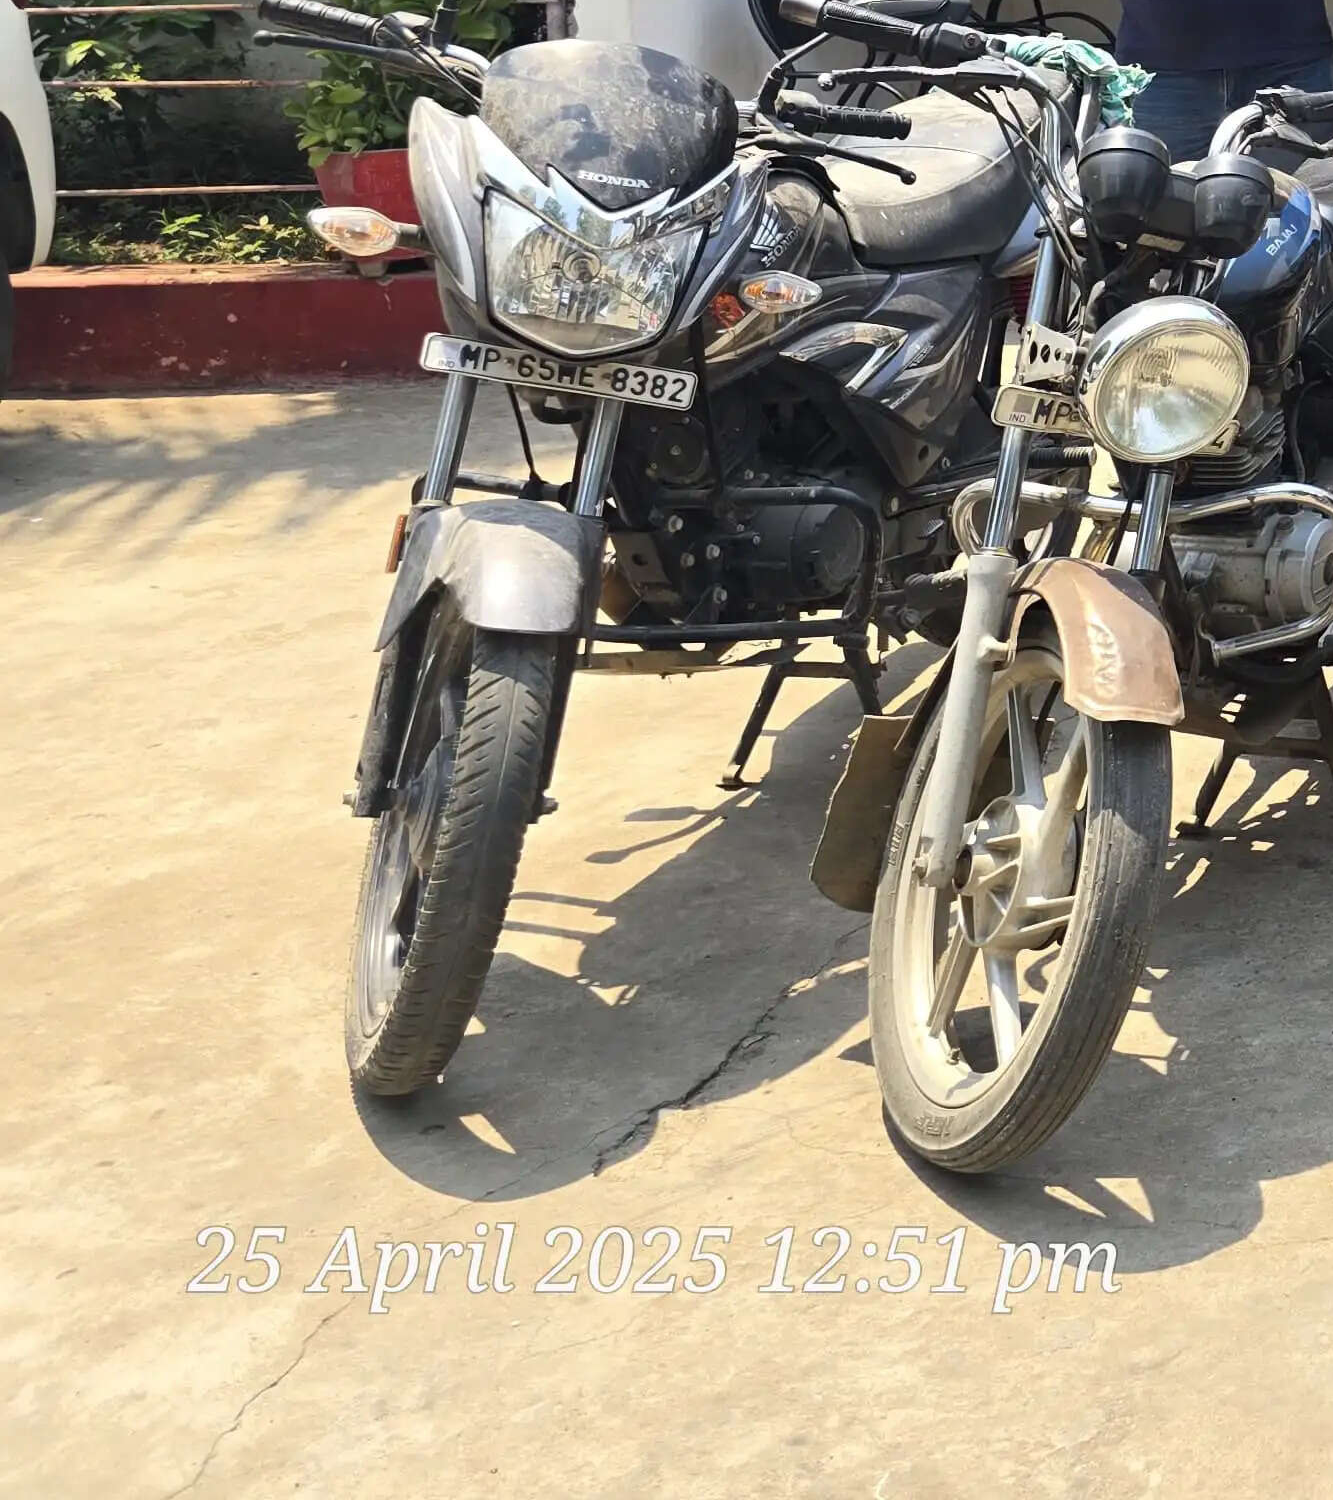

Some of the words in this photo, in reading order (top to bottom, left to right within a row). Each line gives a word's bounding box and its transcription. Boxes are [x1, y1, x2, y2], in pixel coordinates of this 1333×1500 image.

[577, 169, 651, 189] HONDA
[611, 366, 688, 404] 8382
[1008, 413, 1026, 424] IND
